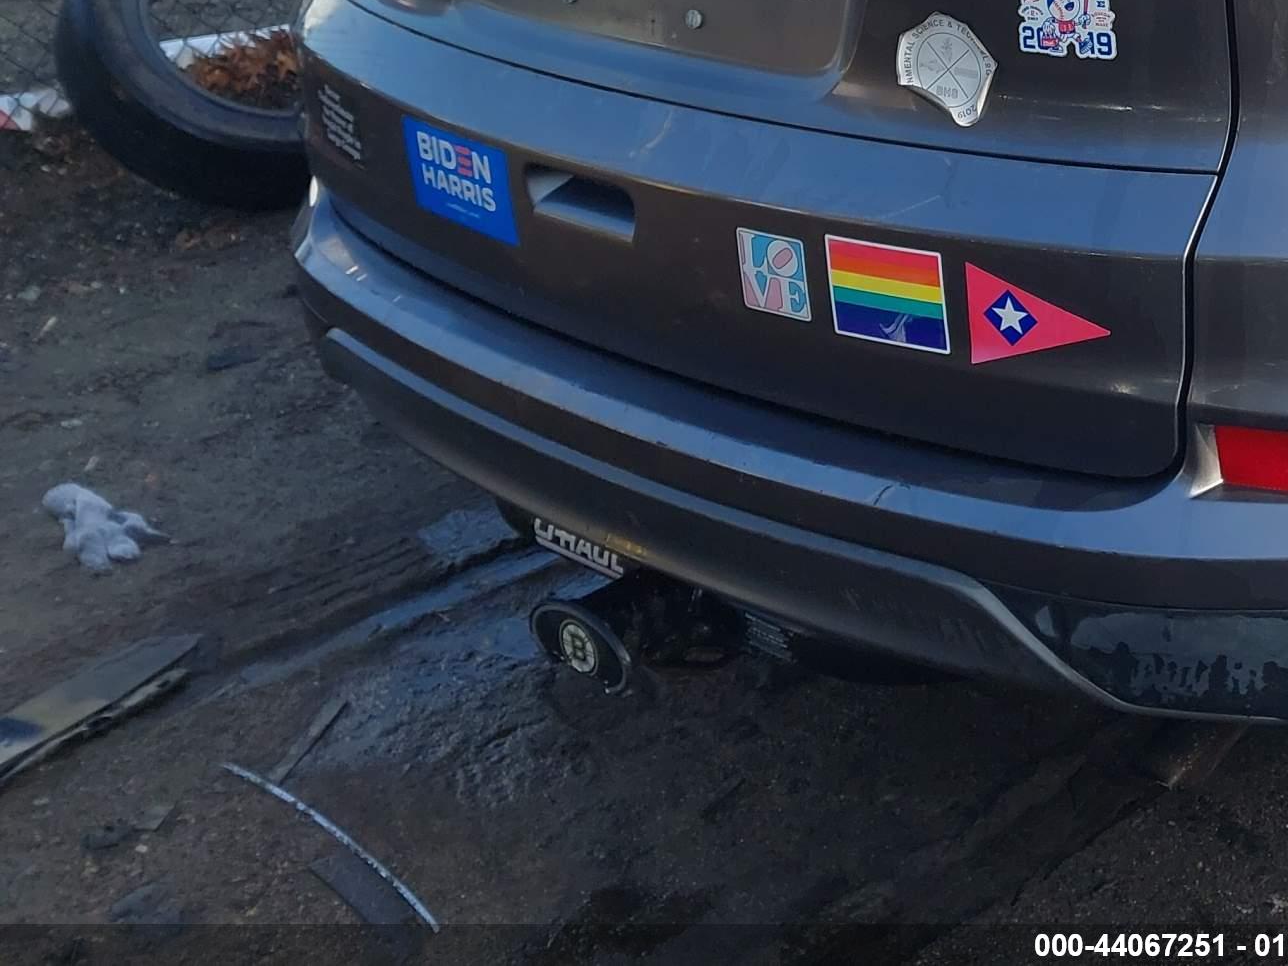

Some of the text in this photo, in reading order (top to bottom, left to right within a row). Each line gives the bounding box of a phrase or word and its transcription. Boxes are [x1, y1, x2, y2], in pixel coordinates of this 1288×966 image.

[912, 19, 945, 40] SCIENCE
[947, 20, 953, 28] &
[416, 131, 491, 184] BIDEN
[422, 162, 496, 212] HARRIS
